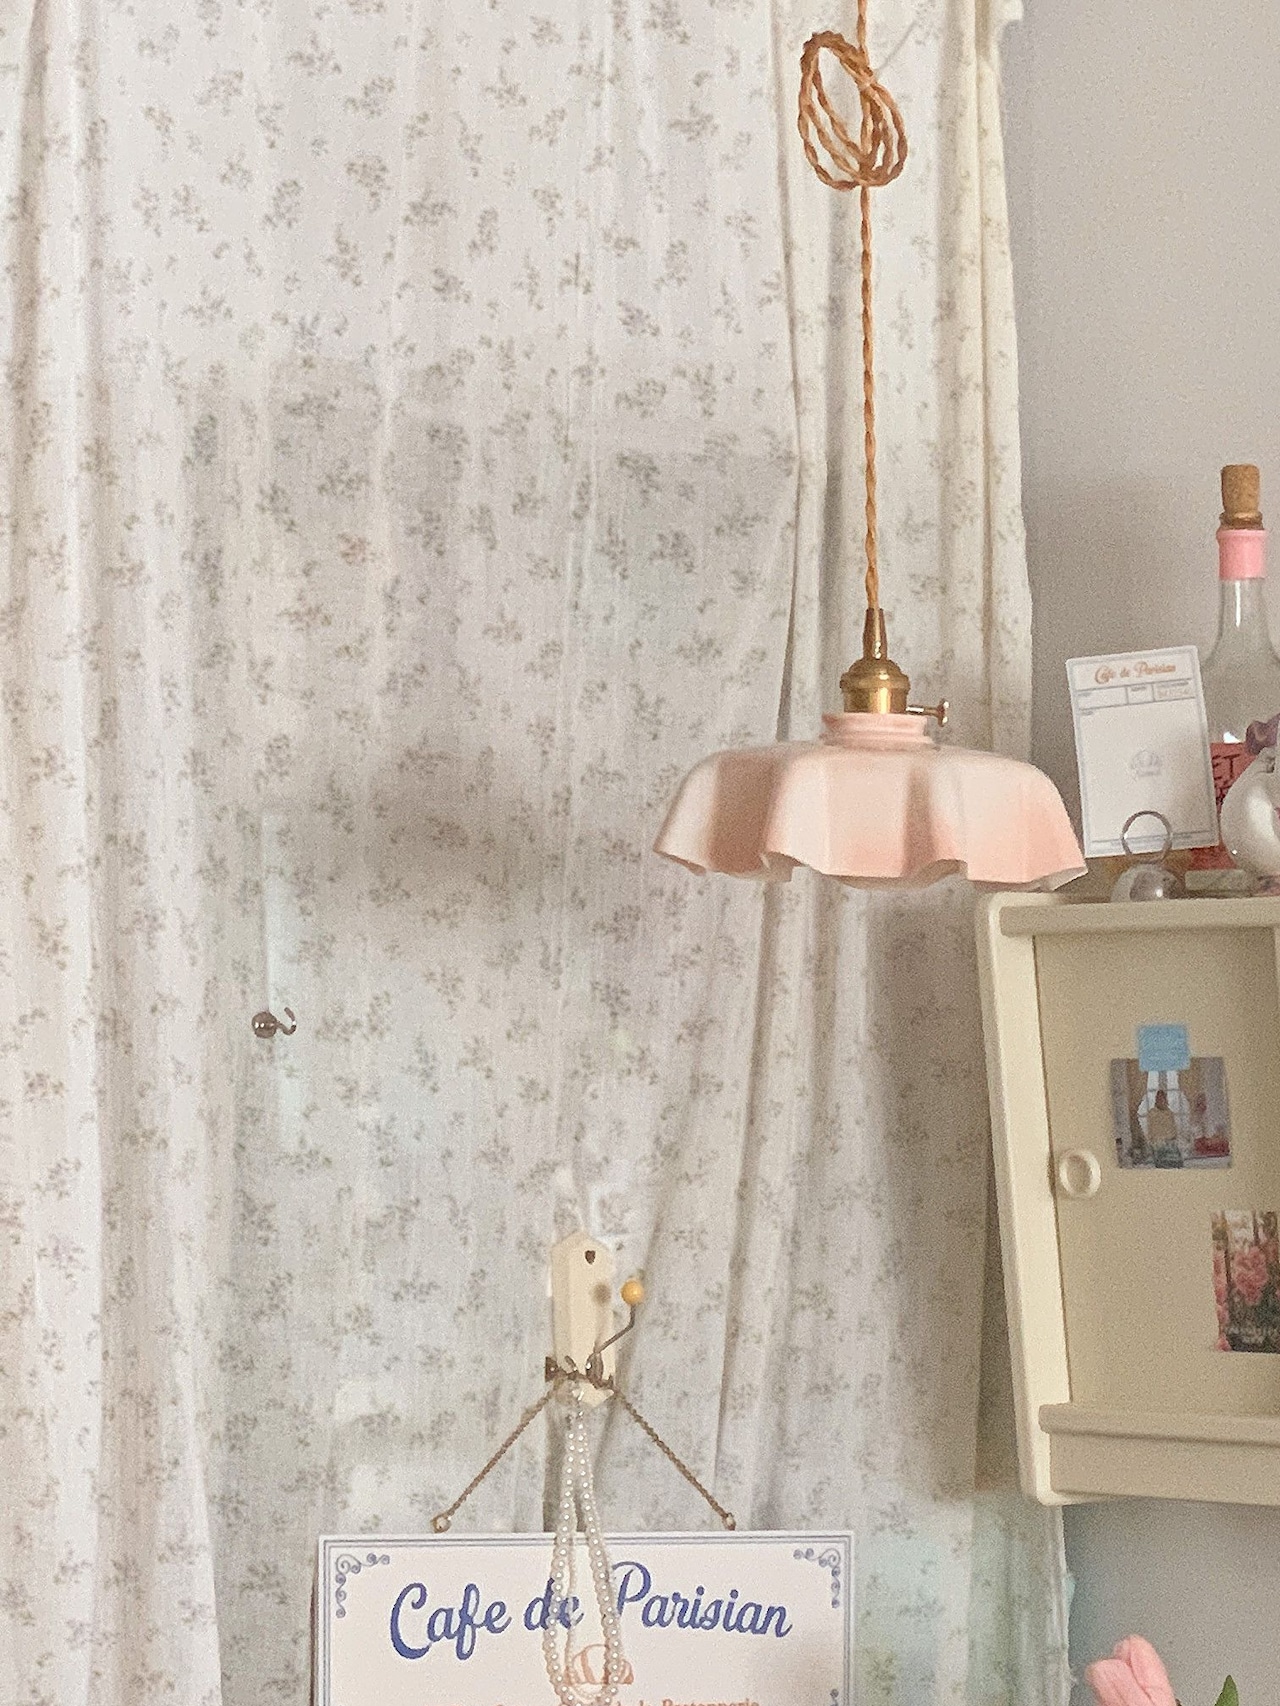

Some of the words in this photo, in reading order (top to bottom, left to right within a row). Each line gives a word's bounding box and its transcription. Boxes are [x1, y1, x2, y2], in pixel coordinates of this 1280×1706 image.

[390, 1582, 512, 1660] Cafe
[524, 1577, 584, 1630] de
[612, 1560, 793, 1638] Parisian
